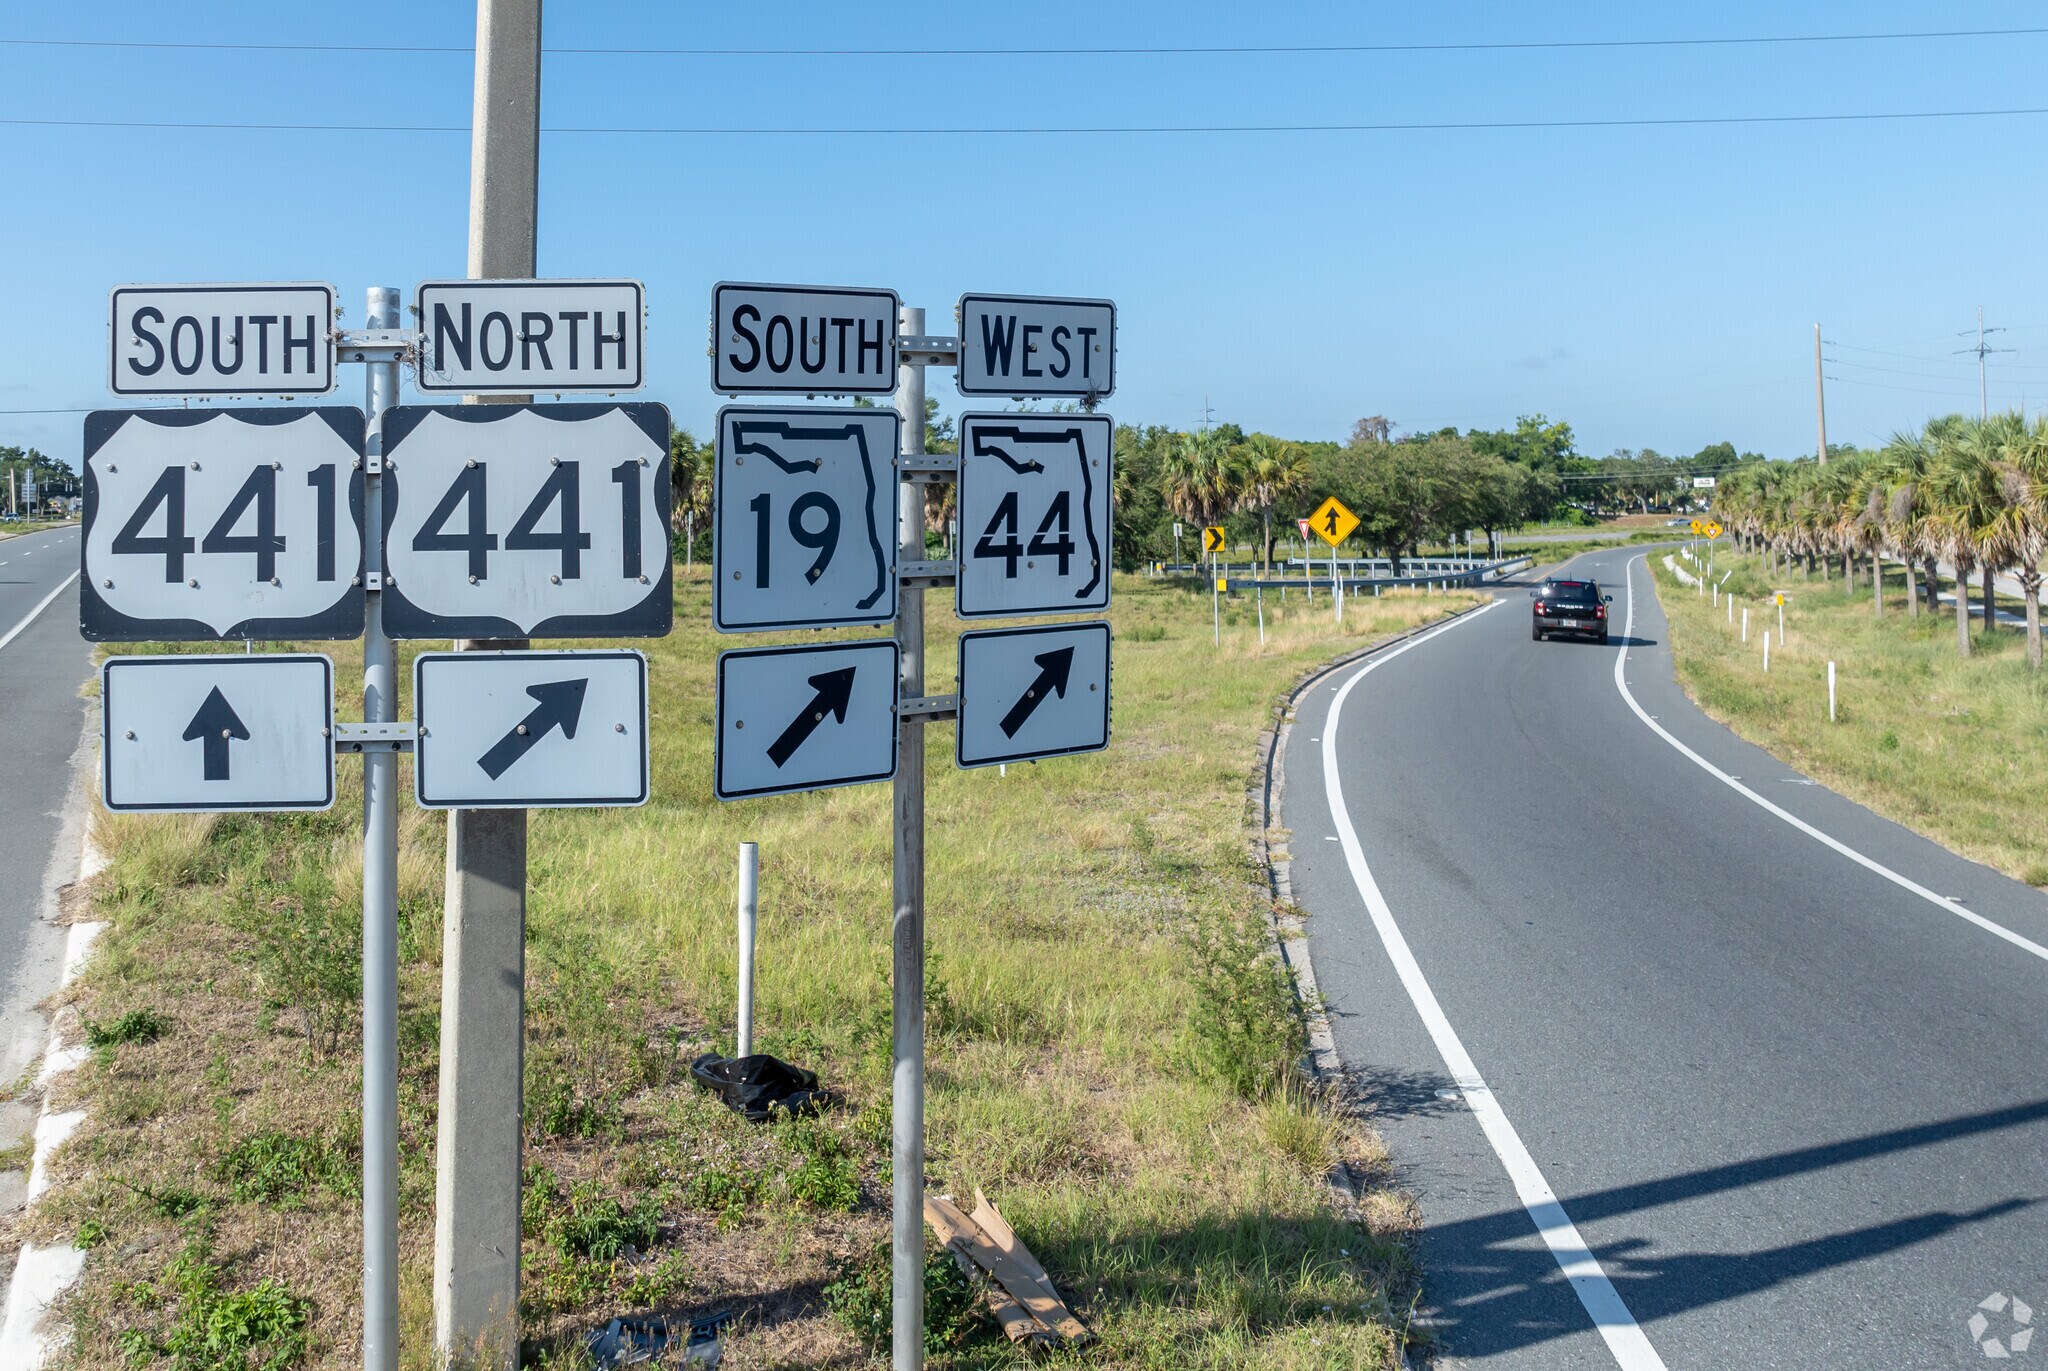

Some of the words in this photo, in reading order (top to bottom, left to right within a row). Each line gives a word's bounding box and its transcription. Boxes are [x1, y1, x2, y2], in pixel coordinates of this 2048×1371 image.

[128, 306, 316, 376] SOUTH
[434, 303, 626, 371] NORTH
[729, 304, 883, 375] SOUTH
[981, 315, 1097, 378] WEST
[112, 463, 336, 583] 441
[412, 460, 642, 580] 441
[750, 491, 841, 589] 19
[974, 491, 1075, 579] 44
